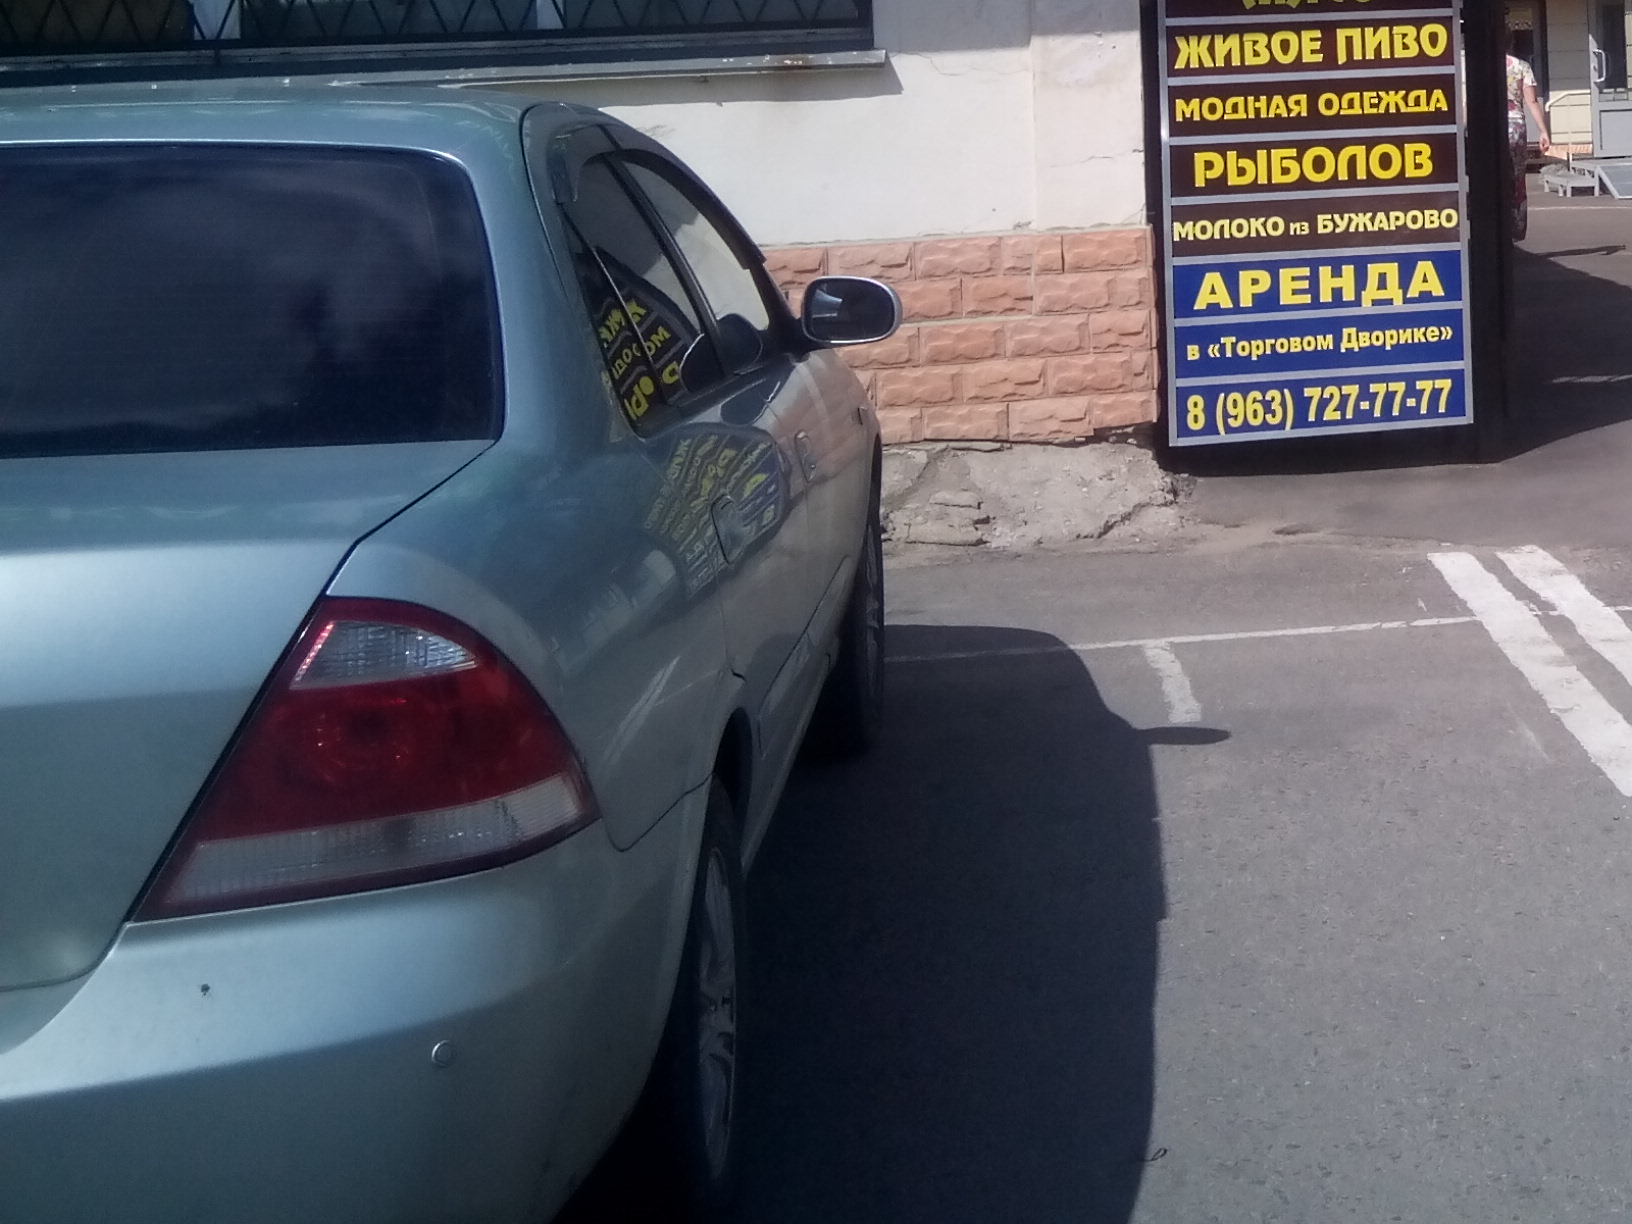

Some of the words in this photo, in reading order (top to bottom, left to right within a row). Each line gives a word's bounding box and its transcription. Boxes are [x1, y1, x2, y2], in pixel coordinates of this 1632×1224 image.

[1174, 29, 1324, 70] ЖИВОЕ
[1336, 23, 1448, 65] ПИВО
[1175, 92, 1308, 122] МОДНАЯ
[1318, 89, 1449, 117] ОДЕЖДА
[1193, 142, 1433, 187] РЫБОЛОВ
[1173, 216, 1285, 241] МОЛОКО
[1317, 208, 1459, 235] БУЖАРОВО
[1193, 260, 1445, 310] АРЕНДА
[1187, 344, 1200, 361] в
[1208, 334, 1334, 361] «Торговом
[1340, 325, 1453, 353] Дворике»
[1186, 395, 1206, 431] 8
[1216, 388, 1294, 436] (963)
[1304, 378, 1452, 422] 727-77-77
